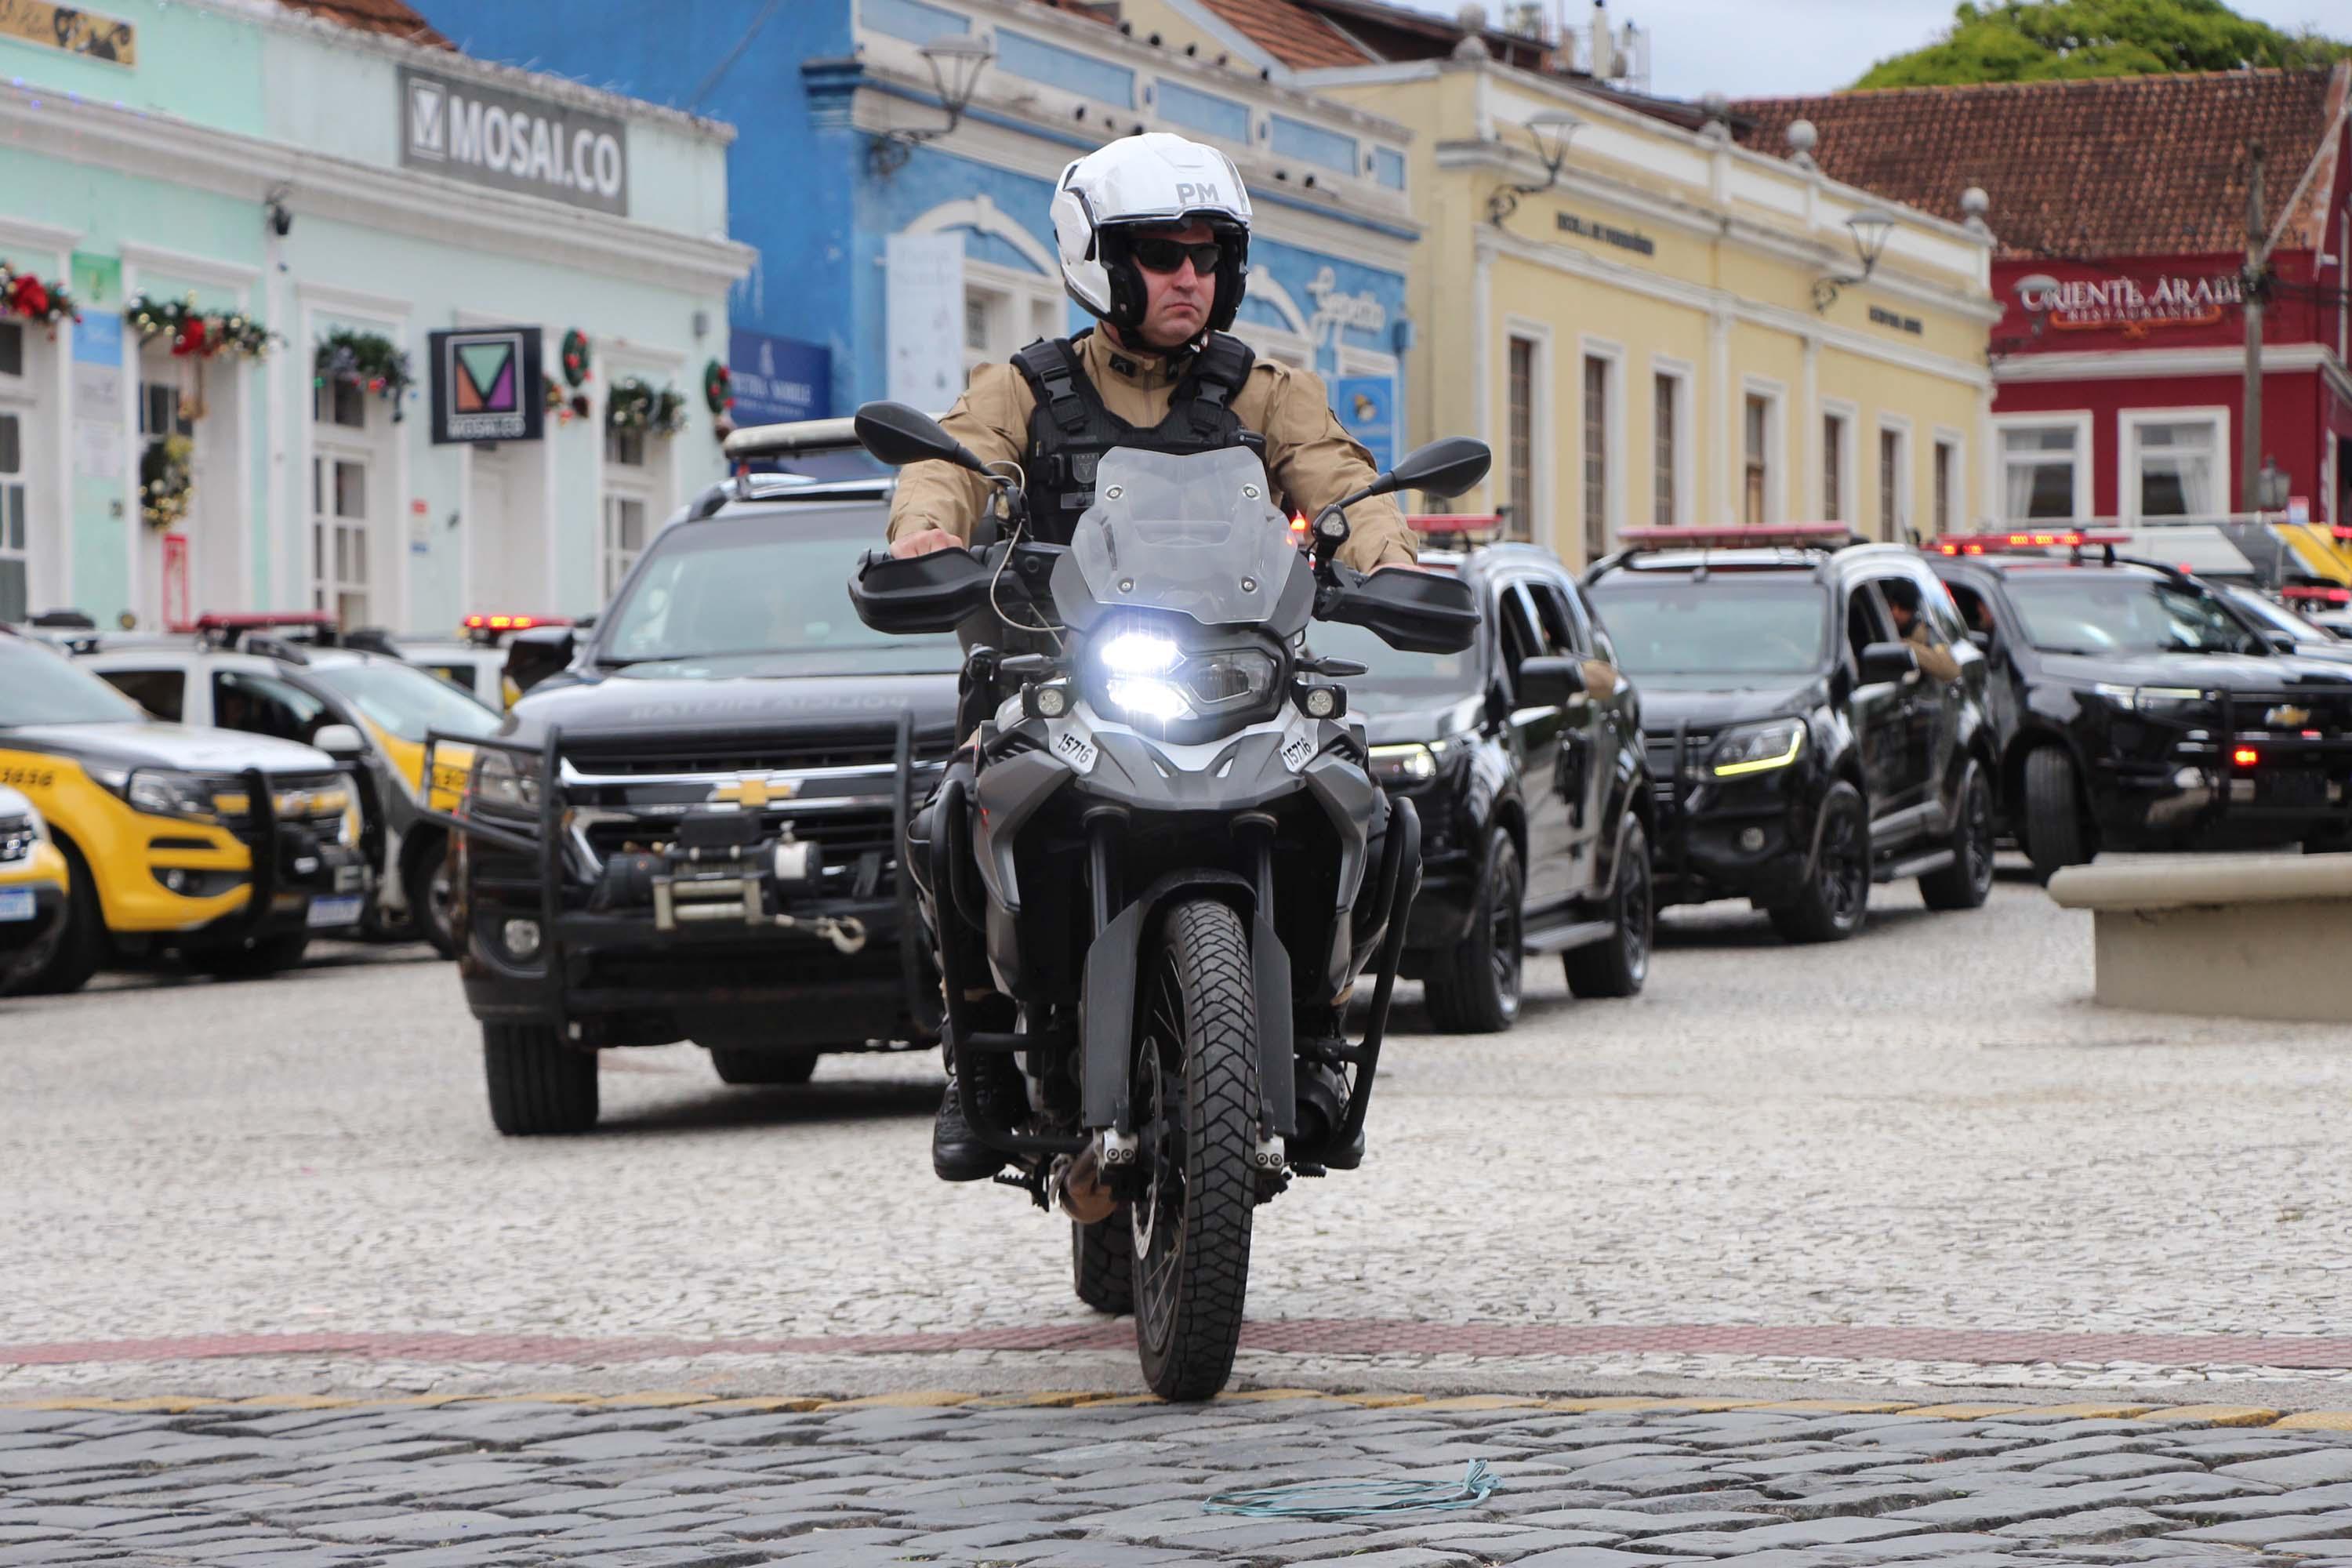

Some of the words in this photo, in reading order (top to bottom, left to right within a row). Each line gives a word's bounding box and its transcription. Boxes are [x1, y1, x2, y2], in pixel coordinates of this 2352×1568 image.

[449, 95, 622, 196] MOSAI.CO
[1176, 183, 1220, 204] PM
[1058, 733, 1093, 763] 15716
[1283, 737, 1312, 766] 15716
